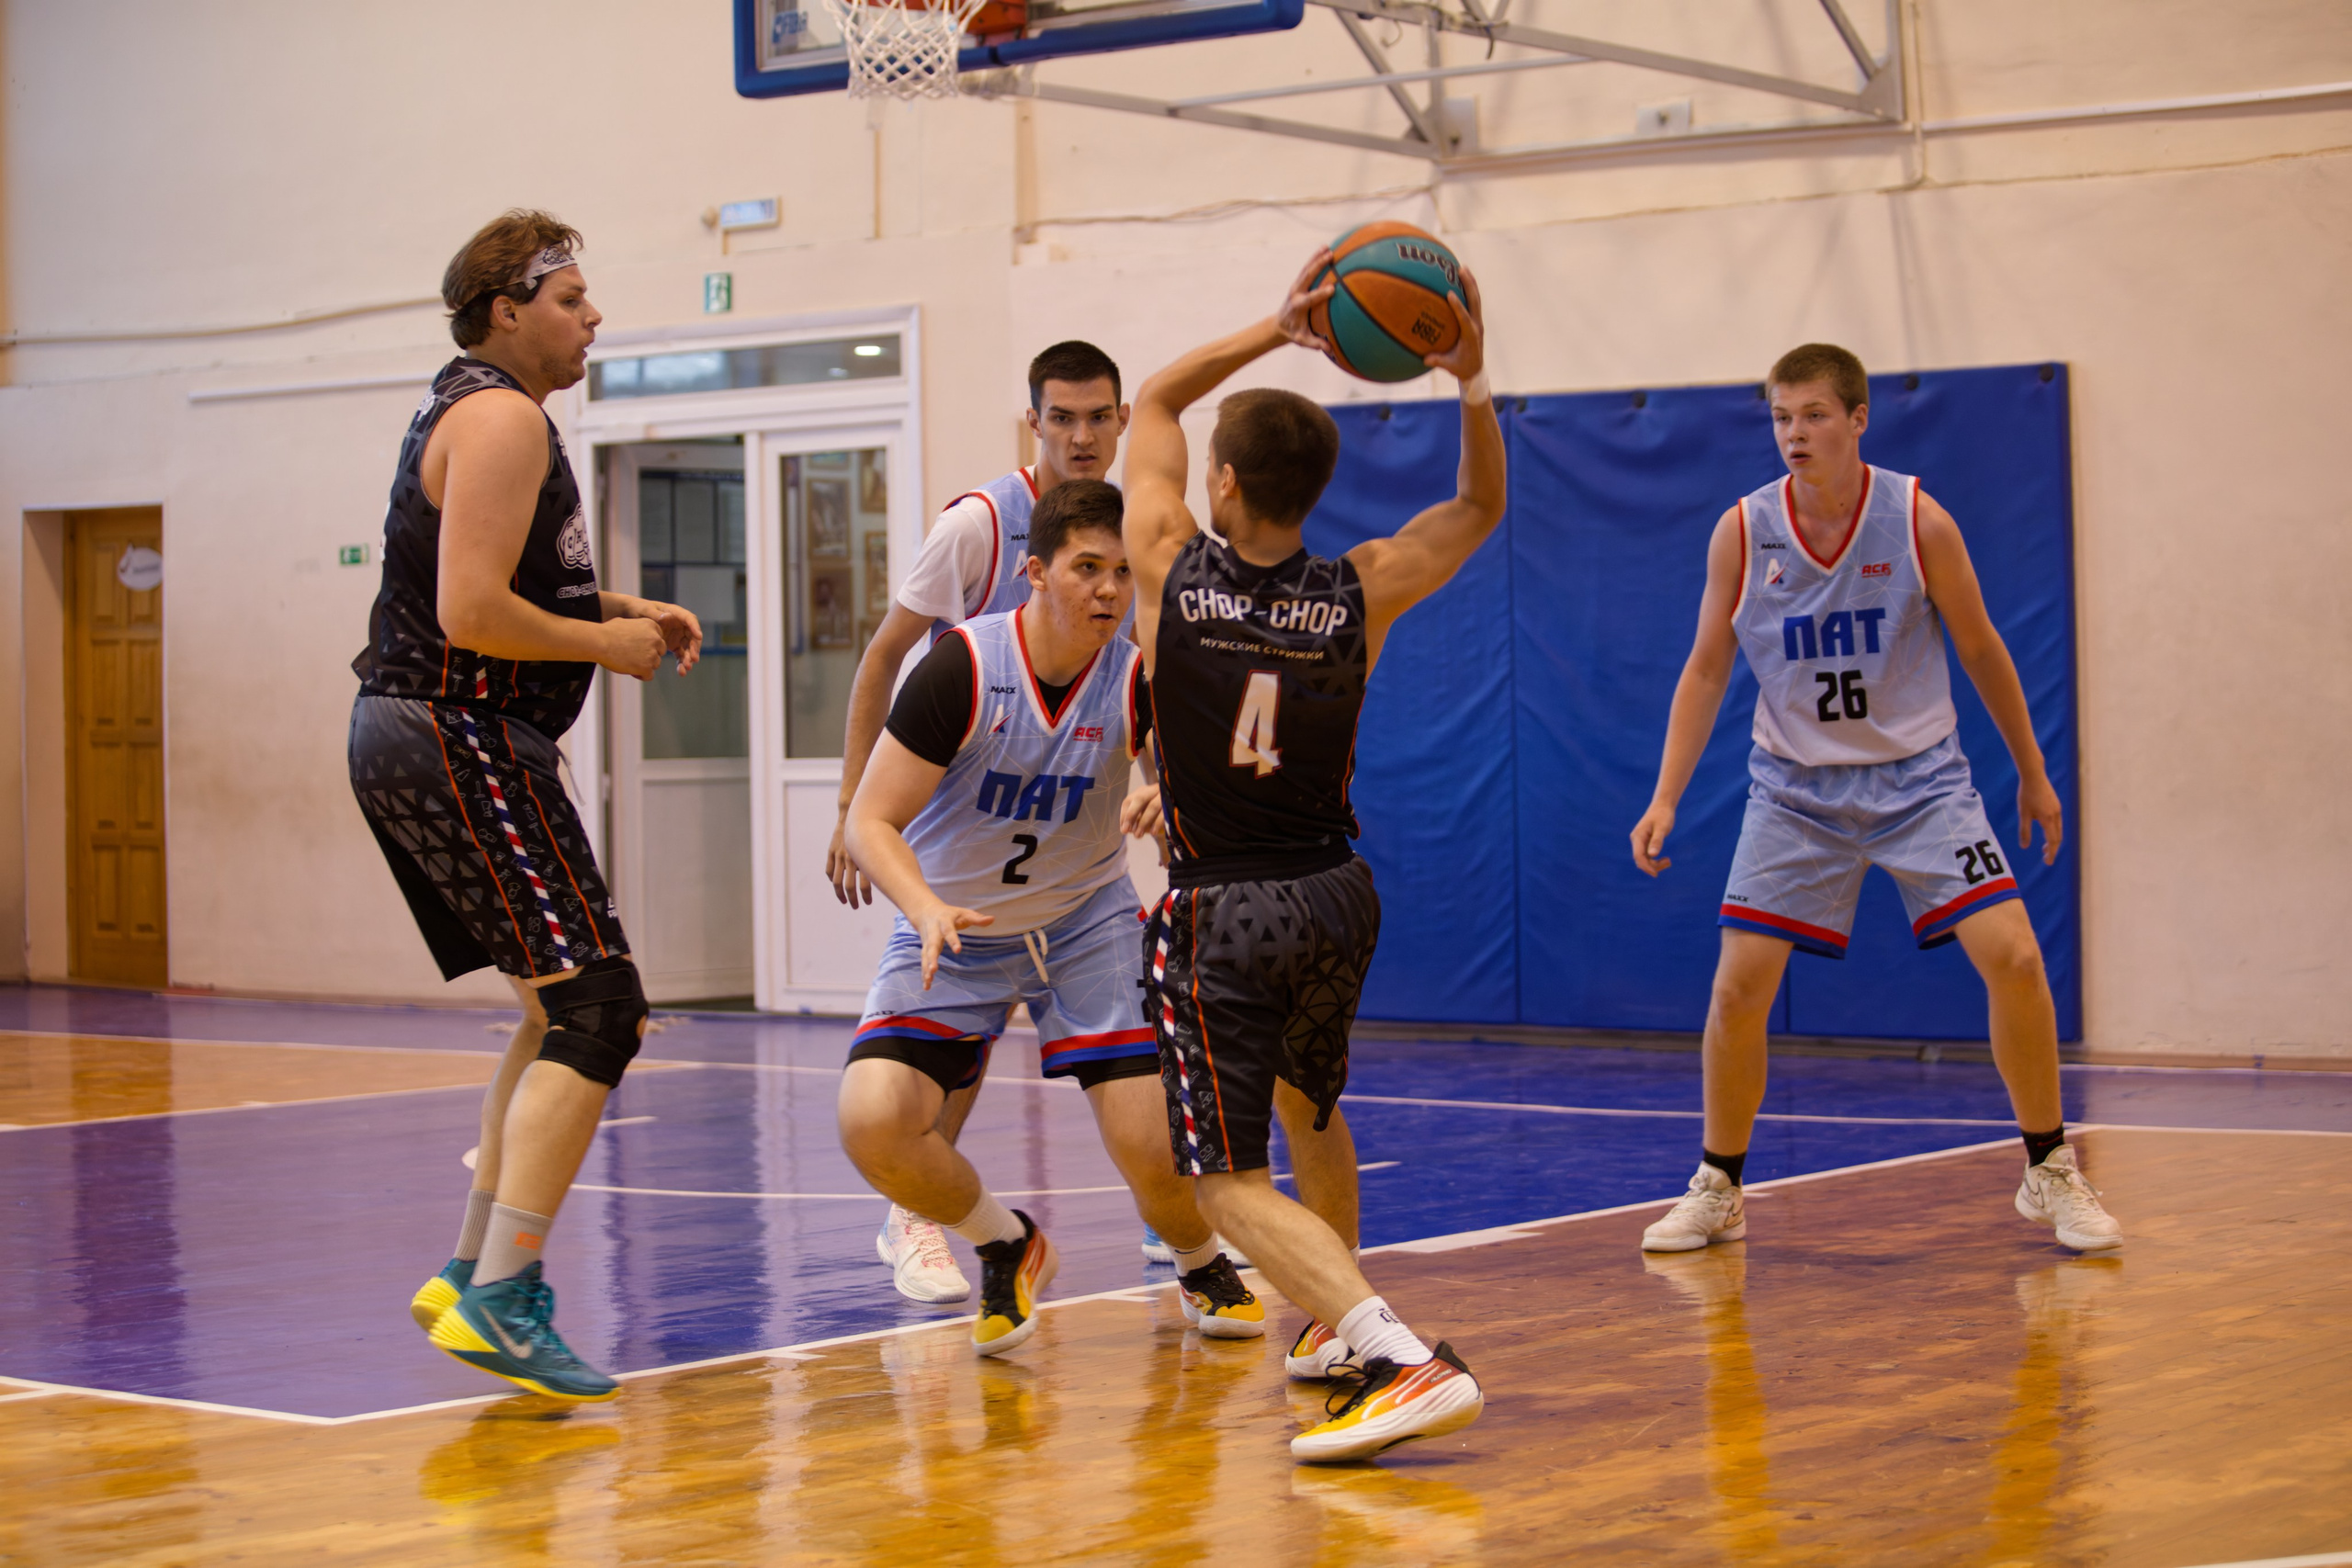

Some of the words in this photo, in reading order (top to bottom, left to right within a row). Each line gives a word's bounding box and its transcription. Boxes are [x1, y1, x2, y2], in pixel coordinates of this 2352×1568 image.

[1200, 637, 1261, 653] МУЖСКИЕ
[1263, 646, 1324, 660] СТРИЖКИ
[1782, 607, 1886, 660] ПАТ
[1815, 670, 1868, 722] 26
[1229, 669, 1283, 779] 4
[976, 768, 1096, 824] ПАТ
[1001, 833, 1038, 885] 2
[1955, 839, 2005, 885] 26
